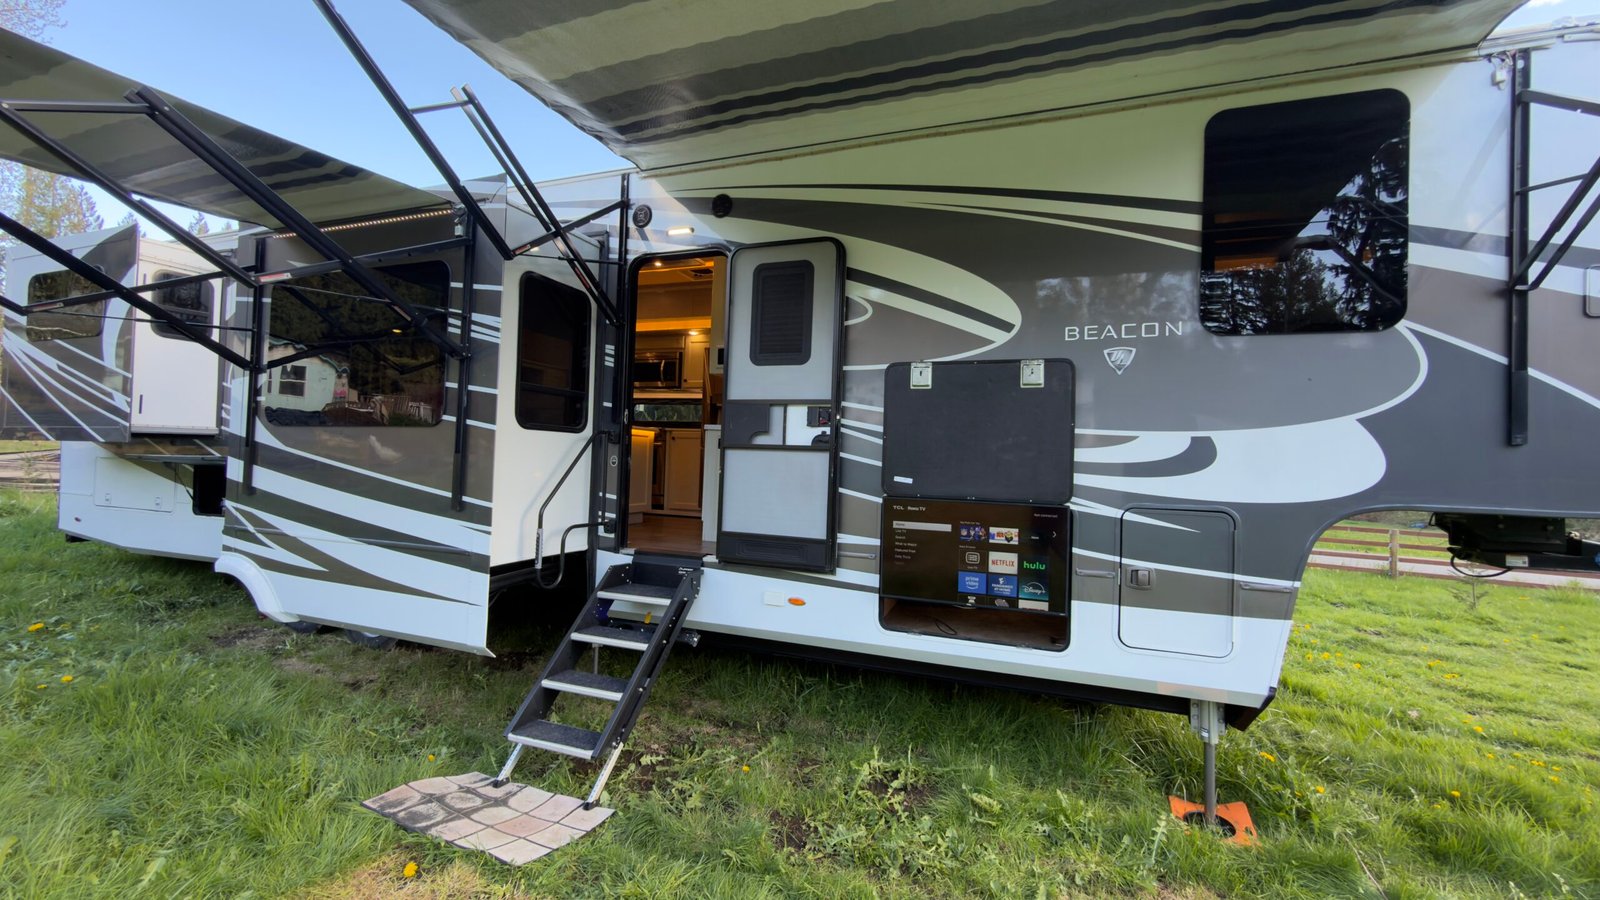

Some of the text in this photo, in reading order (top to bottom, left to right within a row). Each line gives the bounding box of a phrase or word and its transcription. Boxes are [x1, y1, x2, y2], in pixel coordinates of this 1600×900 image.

[1065, 321, 1182, 341] BEACON
[991, 559, 1015, 567] NETFLIX
[1023, 561, 1046, 570] hulu
